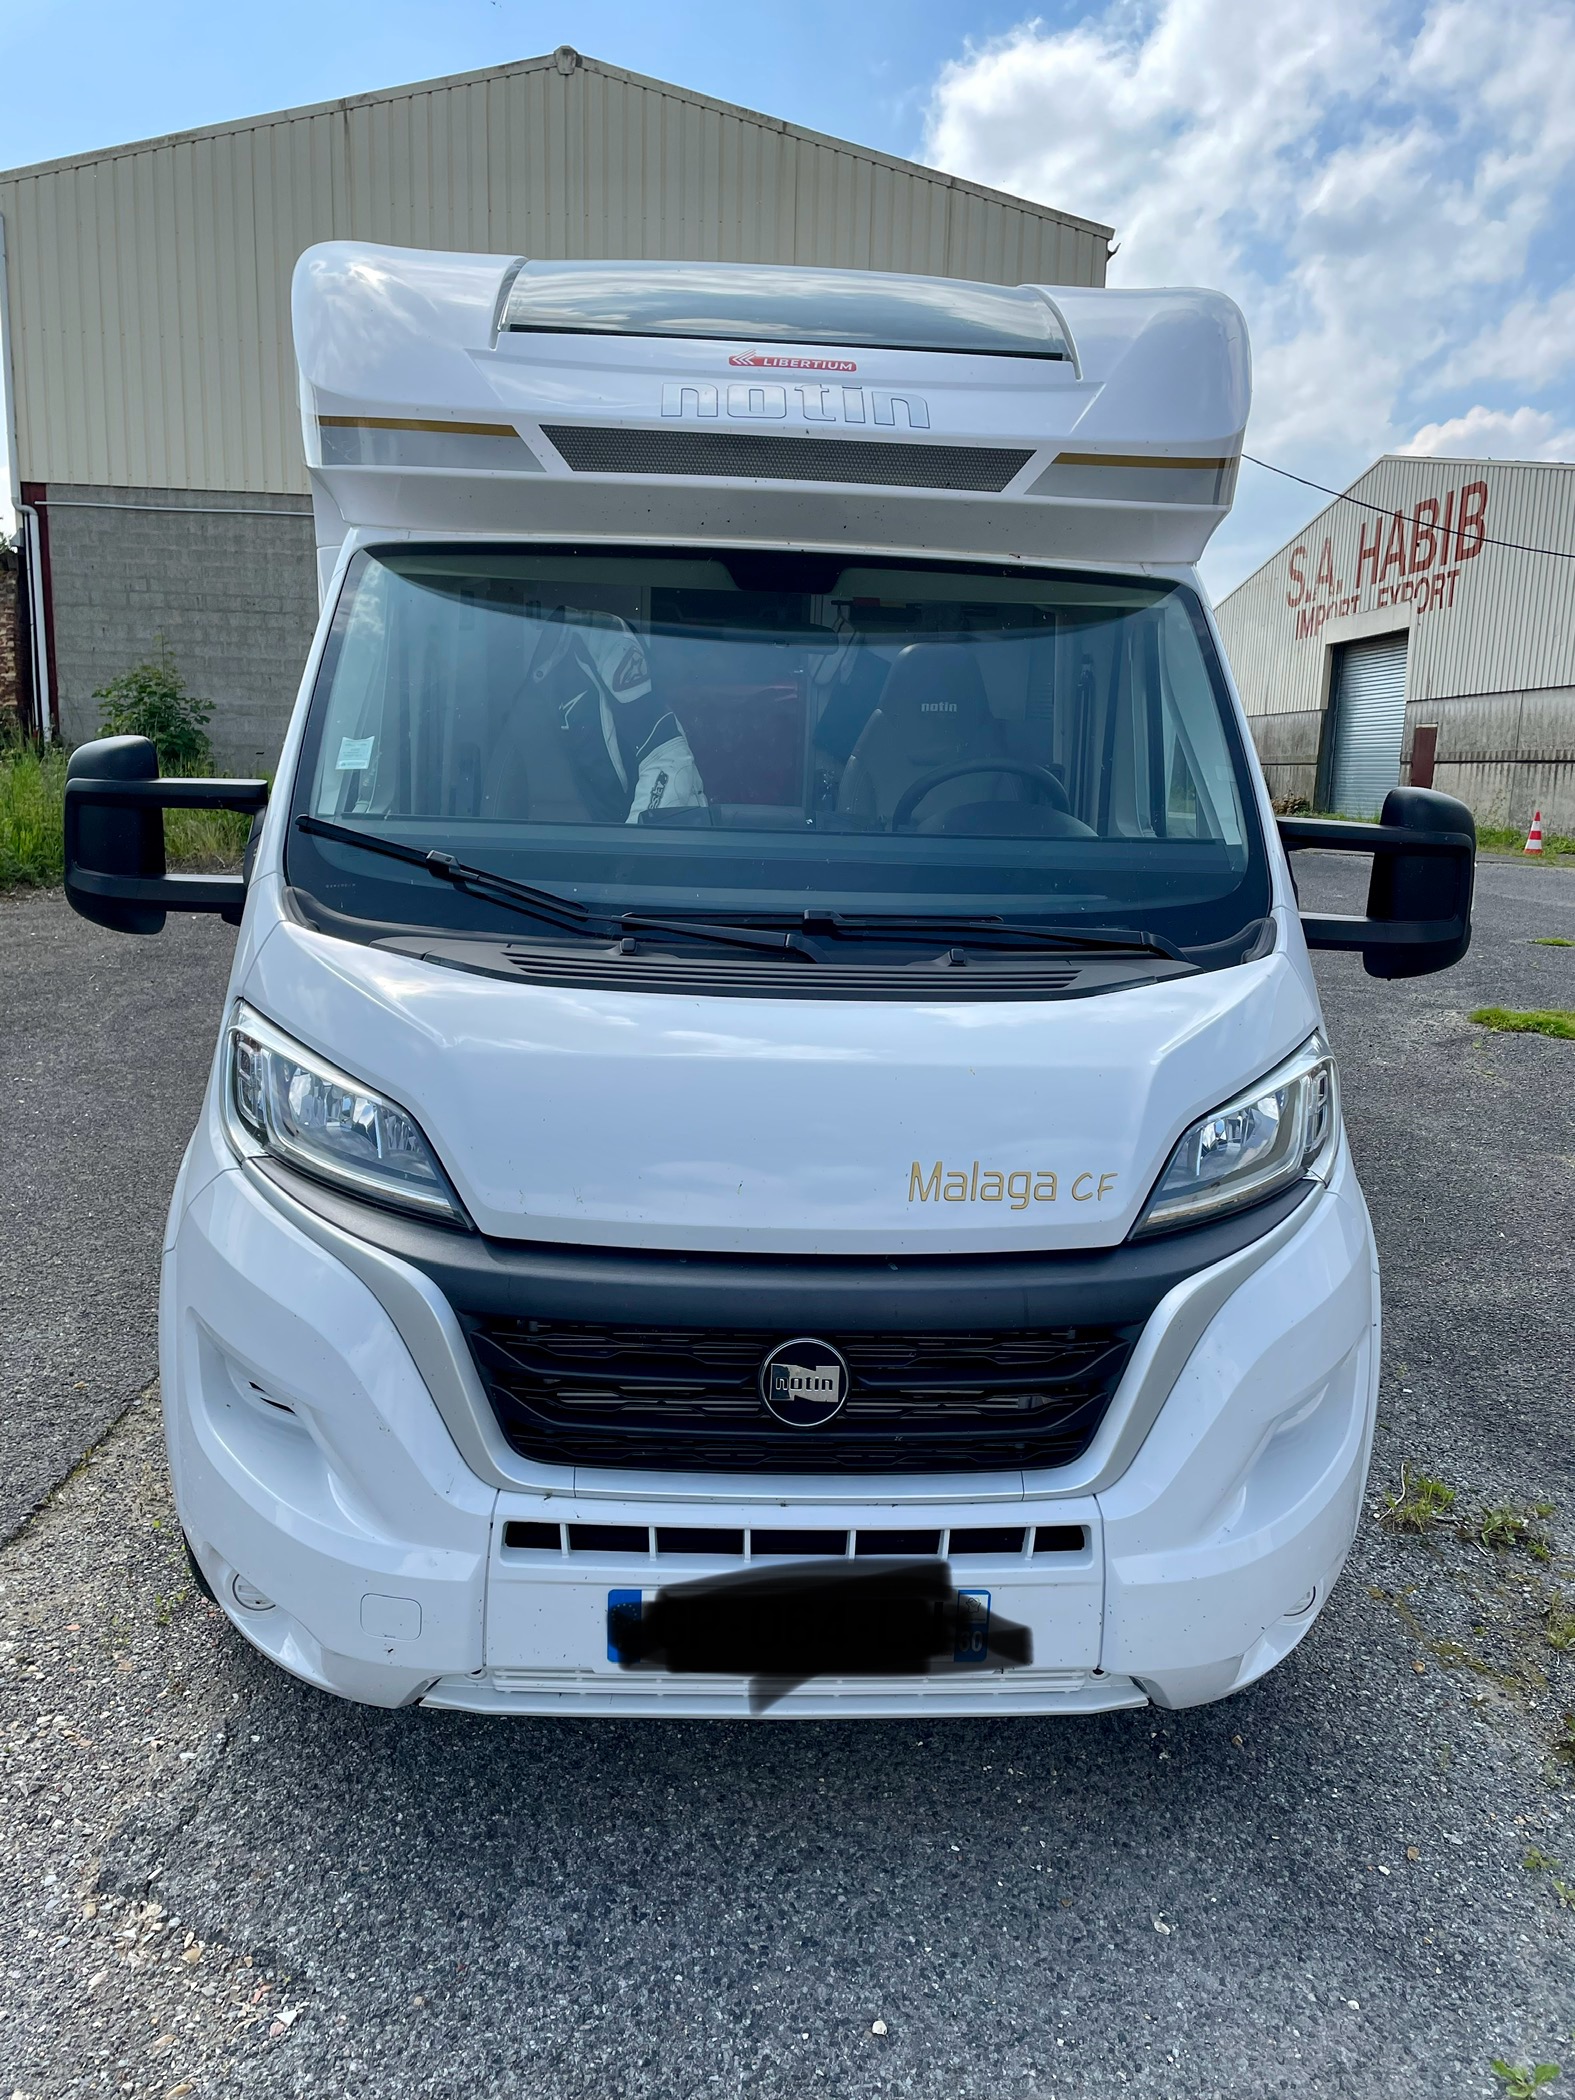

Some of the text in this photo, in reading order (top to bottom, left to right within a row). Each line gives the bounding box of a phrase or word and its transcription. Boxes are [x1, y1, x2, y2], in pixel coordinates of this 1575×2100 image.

[763, 357, 854, 371] LIBERTIUM
[660, 383, 931, 429] notin
[1355, 480, 1488, 589] HABIB
[921, 701, 958, 713] notin
[908, 1160, 1119, 1210] Malaga CF
[775, 1376, 834, 1392] notin
